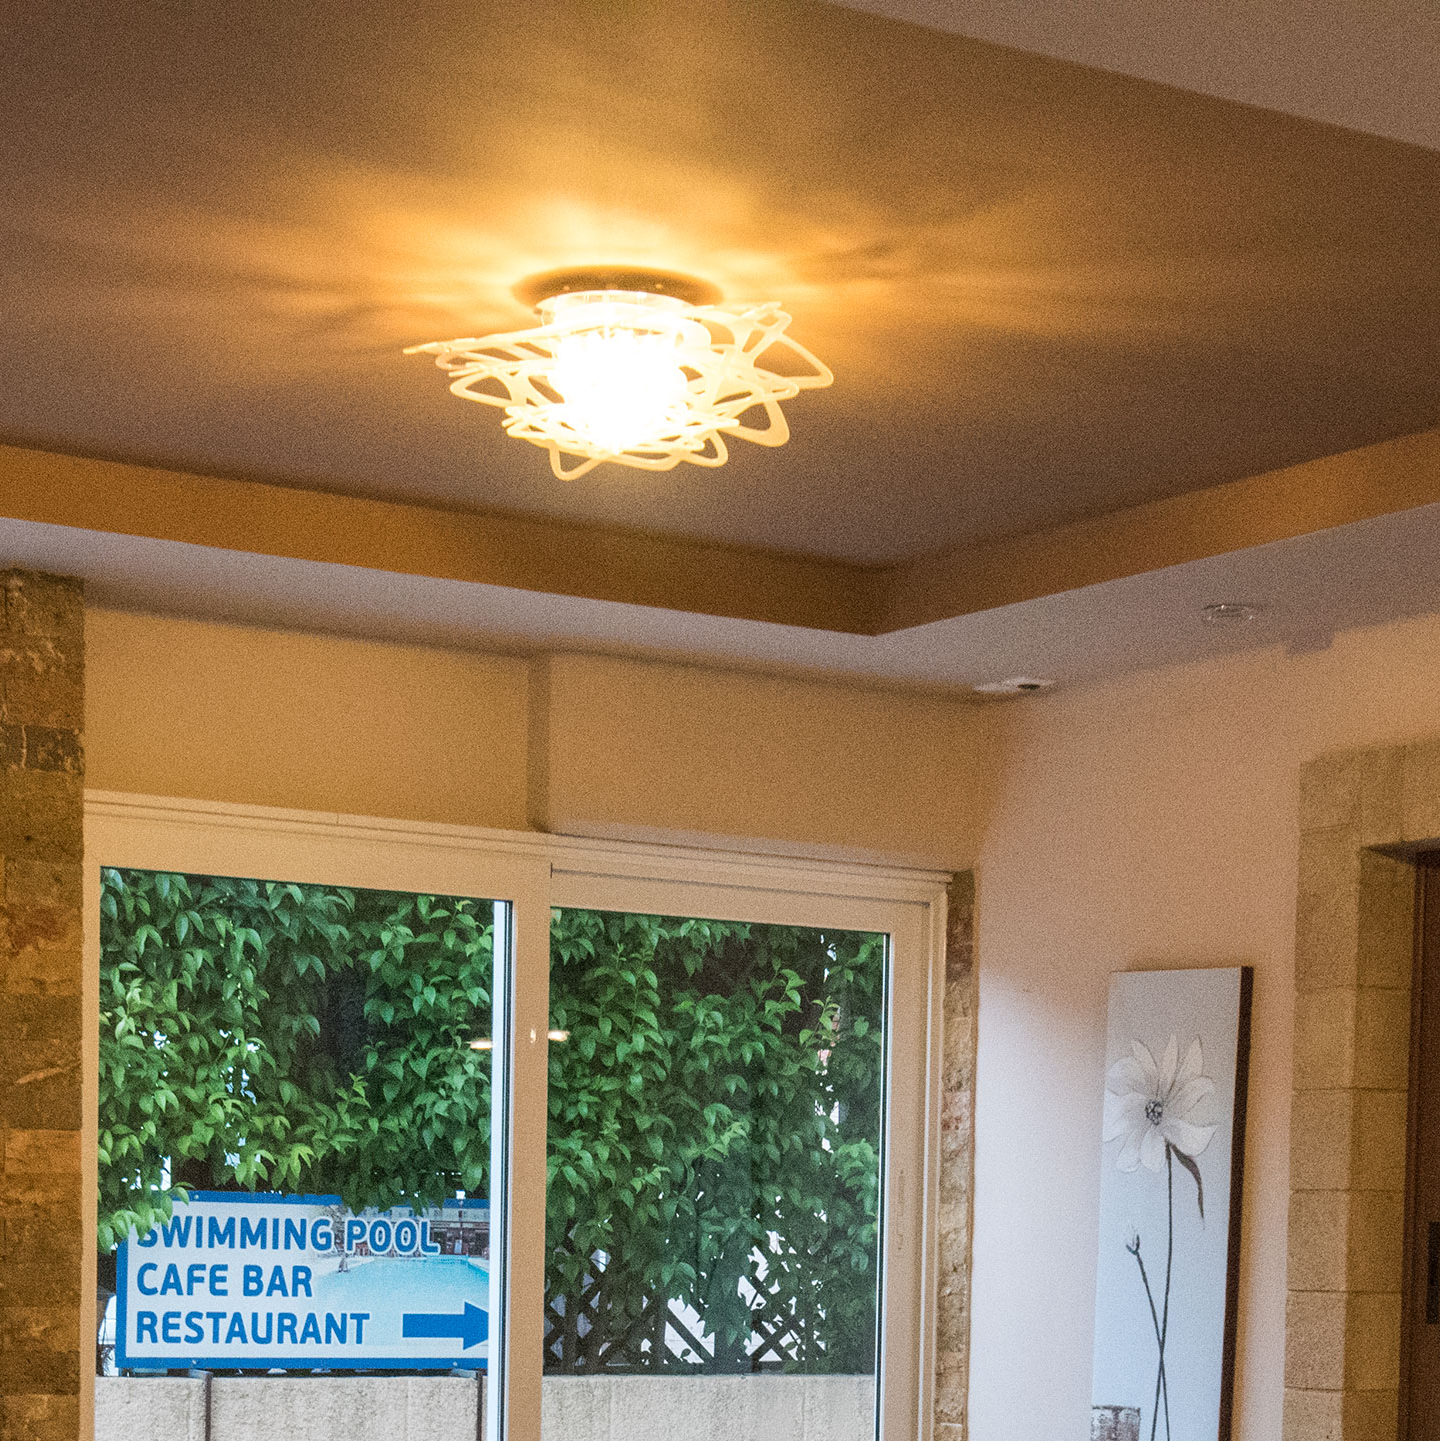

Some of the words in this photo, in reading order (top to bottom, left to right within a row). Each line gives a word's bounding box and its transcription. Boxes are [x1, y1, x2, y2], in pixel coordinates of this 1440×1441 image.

[346, 1219, 441, 1254] POOL
[137, 1263, 228, 1296] CAFE
[243, 1265, 313, 1297] BAR
[136, 1311, 370, 1345] RESTAURANT
